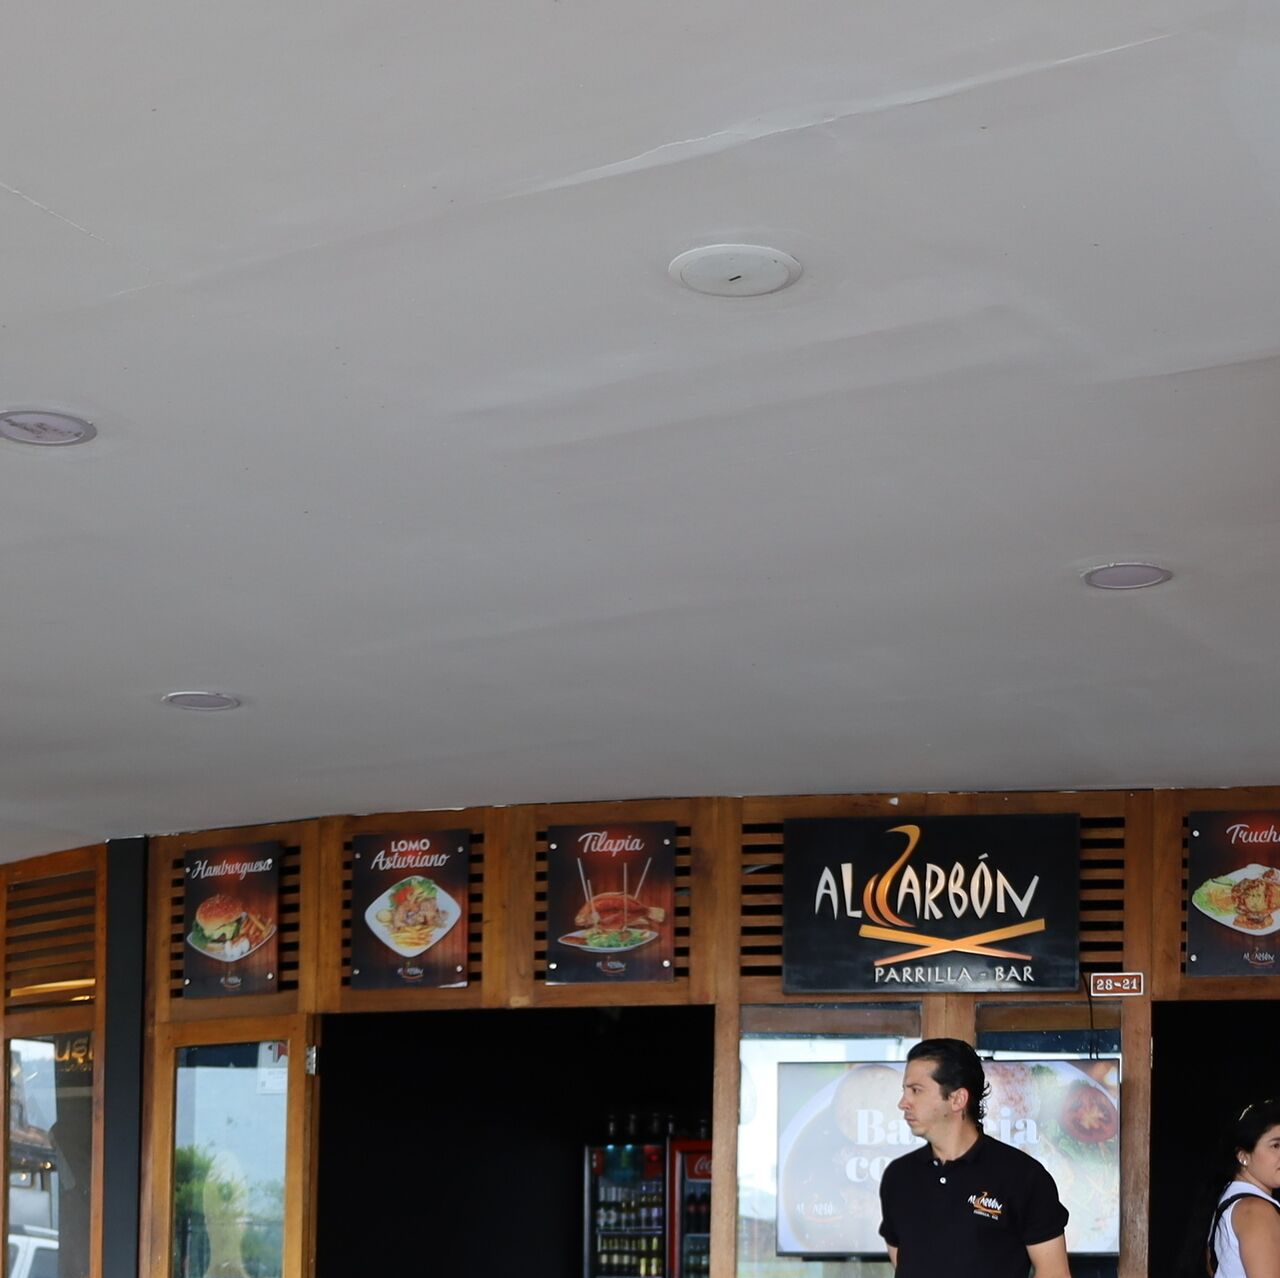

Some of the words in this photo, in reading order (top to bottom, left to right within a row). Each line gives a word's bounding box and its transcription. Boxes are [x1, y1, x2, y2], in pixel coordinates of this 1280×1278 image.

[390, 838, 431, 852] LOMO
[577, 830, 645, 857] Tilapia
[191, 858, 274, 880] Hamburguesa
[370, 850, 451, 871] Asturiano
[815, 862, 862, 921] AL
[874, 966, 973, 983] PARRILLA
[995, 965, 1035, 982] BAR
[1095, 978, 1139, 991] 28-21
